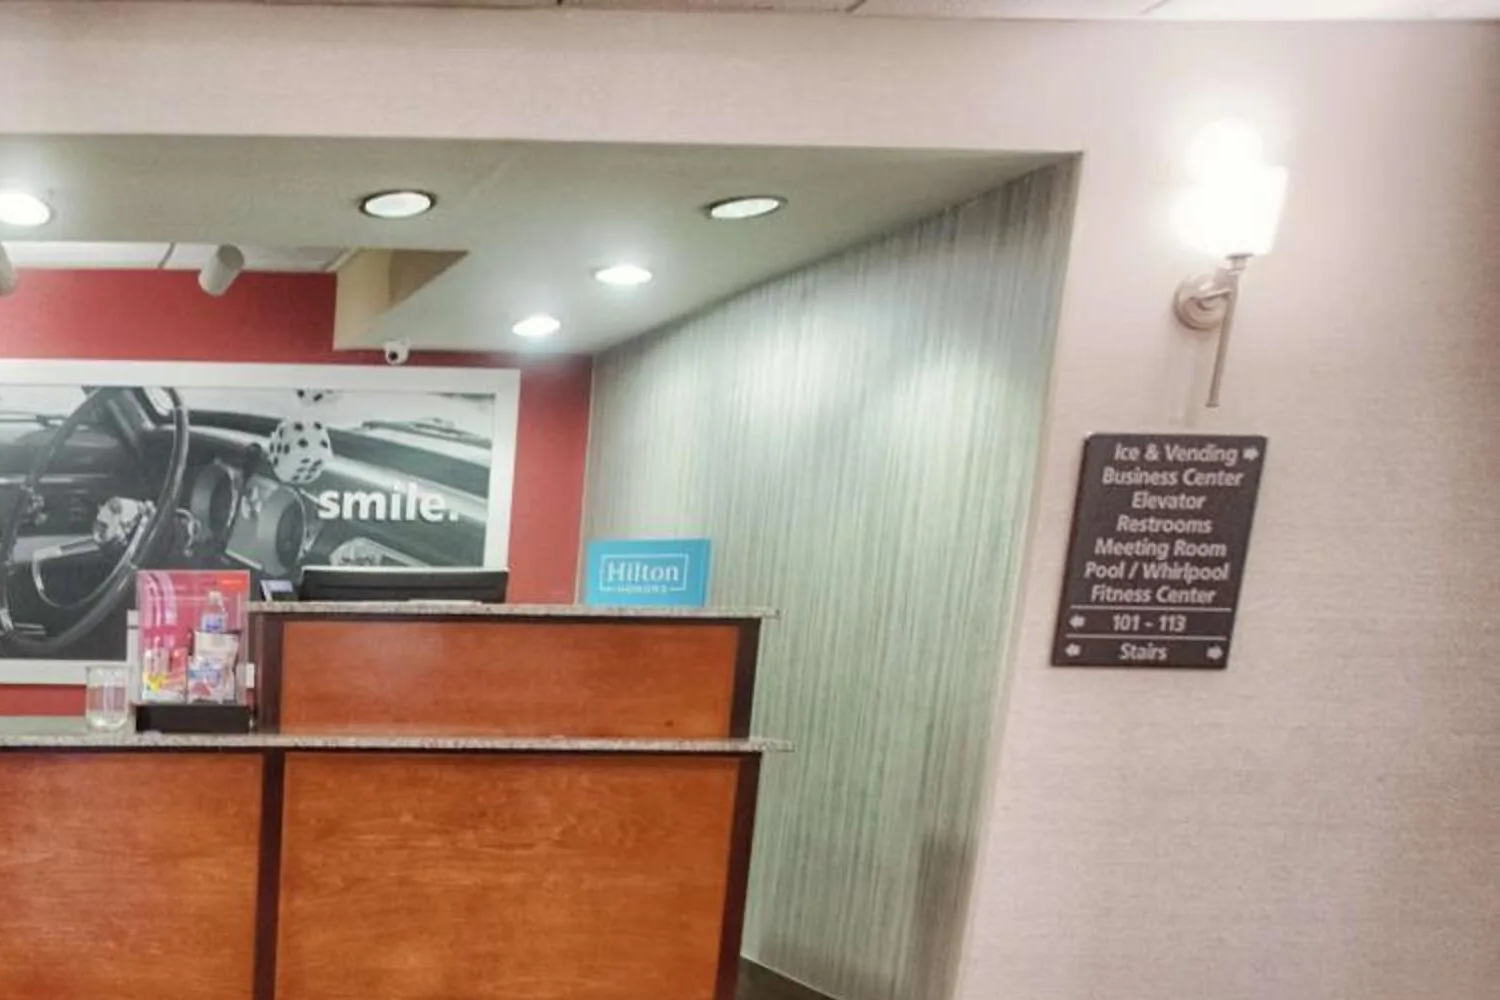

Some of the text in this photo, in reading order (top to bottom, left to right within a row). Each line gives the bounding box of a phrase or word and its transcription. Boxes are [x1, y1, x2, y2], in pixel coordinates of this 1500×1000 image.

[1114, 443, 1238, 466] Ice & Vending
[1102, 467, 1244, 486] Business Center
[318, 482, 458, 522] smile.
[1131, 491, 1207, 509] Elevator
[1116, 515, 1213, 533] Restrooms
[1094, 538, 1228, 560] Meeting Room
[607, 561, 679, 582] Hilton
[1084, 561, 1125, 578] Pool
[1143, 563, 1230, 584] Whirlpool
[1090, 584, 1217, 603] Fitness Center
[1112, 614, 1140, 631] 101
[1158, 615, 1187, 632] 113
[1118, 643, 1168, 661] Stairs
